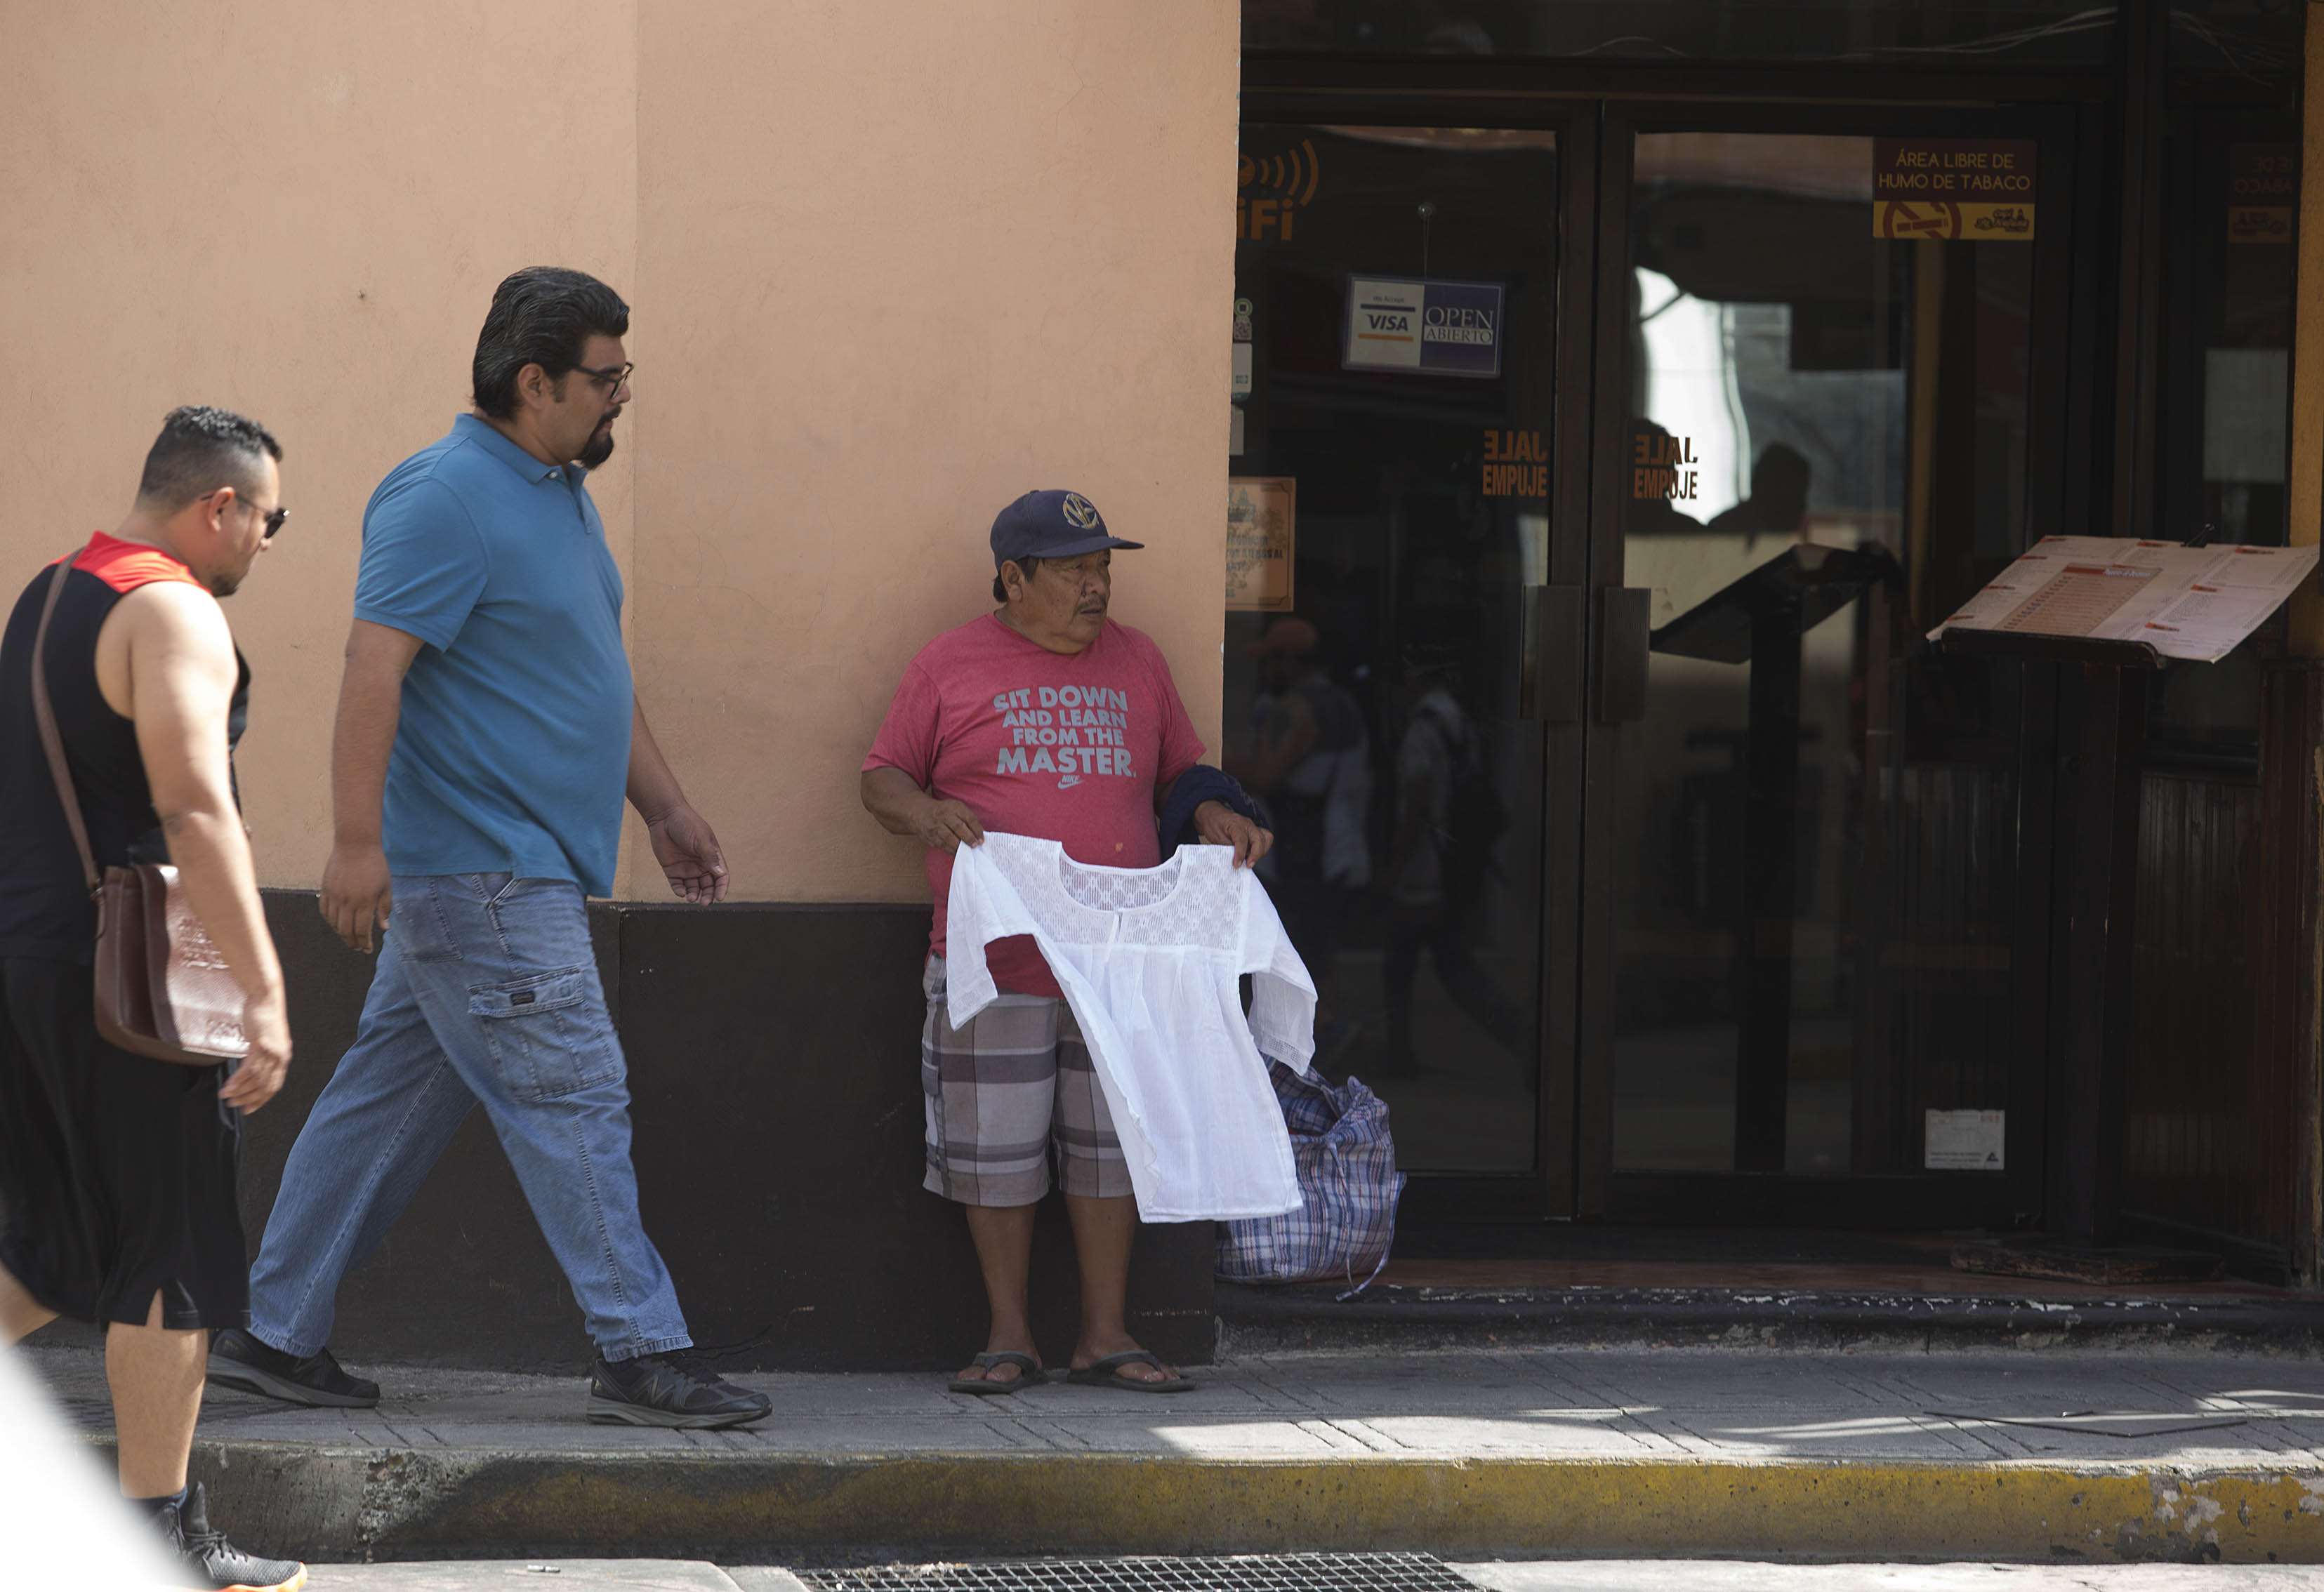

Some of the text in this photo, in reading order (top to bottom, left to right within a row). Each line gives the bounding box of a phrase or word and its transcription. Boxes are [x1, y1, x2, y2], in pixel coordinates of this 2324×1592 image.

[1896, 148, 2014, 168] ÁREA LIBRE DE
[1879, 174, 2031, 190] HUMO DE TABACO
[1236, 197, 1293, 241] iFi
[1367, 314, 1408, 332] VISA
[1425, 307, 1493, 329] OPEN
[1425, 328, 1493, 343] ABIERTO
[1483, 465, 1547, 497] EMPUJE
[1635, 467, 1698, 499] EMPUJE
[993, 685, 1128, 712] SIT DOWN
[1002, 709, 1127, 729] AND LEARN
[1012, 727, 1124, 746] FROM THE
[996, 747, 1137, 778] MASTER.
[1062, 775, 1081, 783] NIKE
